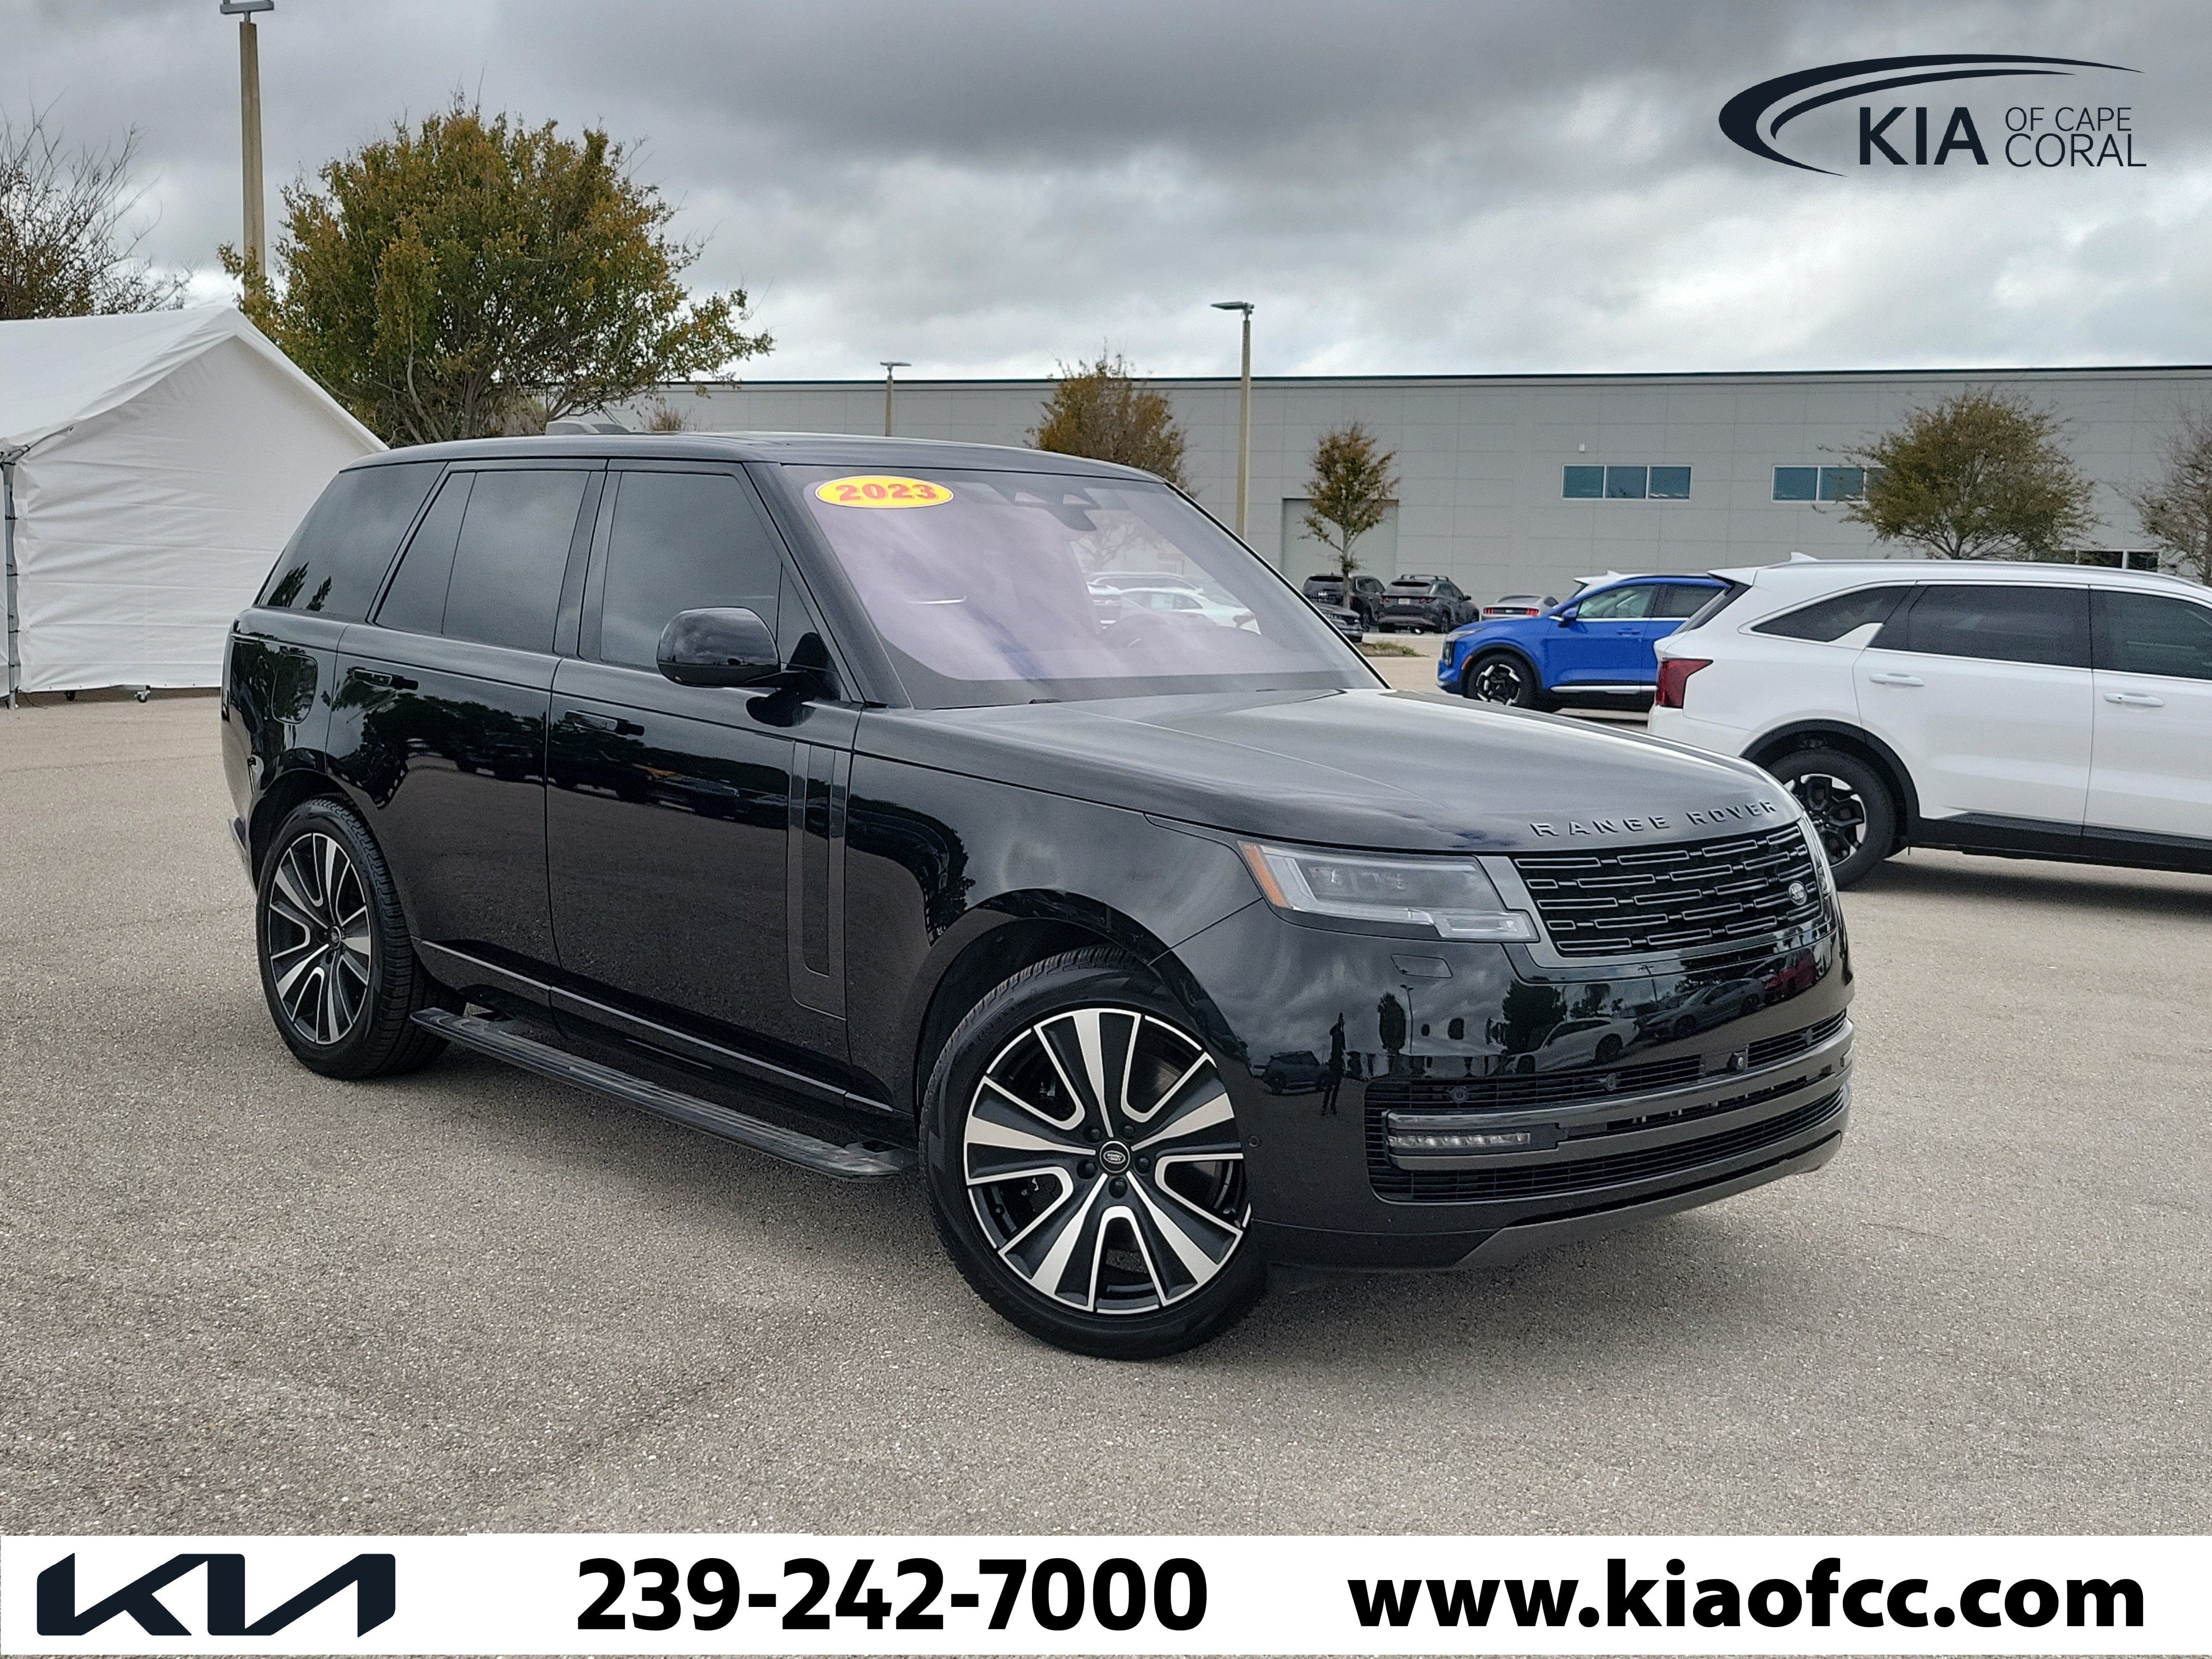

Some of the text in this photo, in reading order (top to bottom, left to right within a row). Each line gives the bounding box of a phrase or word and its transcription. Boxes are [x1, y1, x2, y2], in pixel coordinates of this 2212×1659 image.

[836, 483, 939, 501] 2023
[1530, 800, 1778, 837] RANGE ROVER
